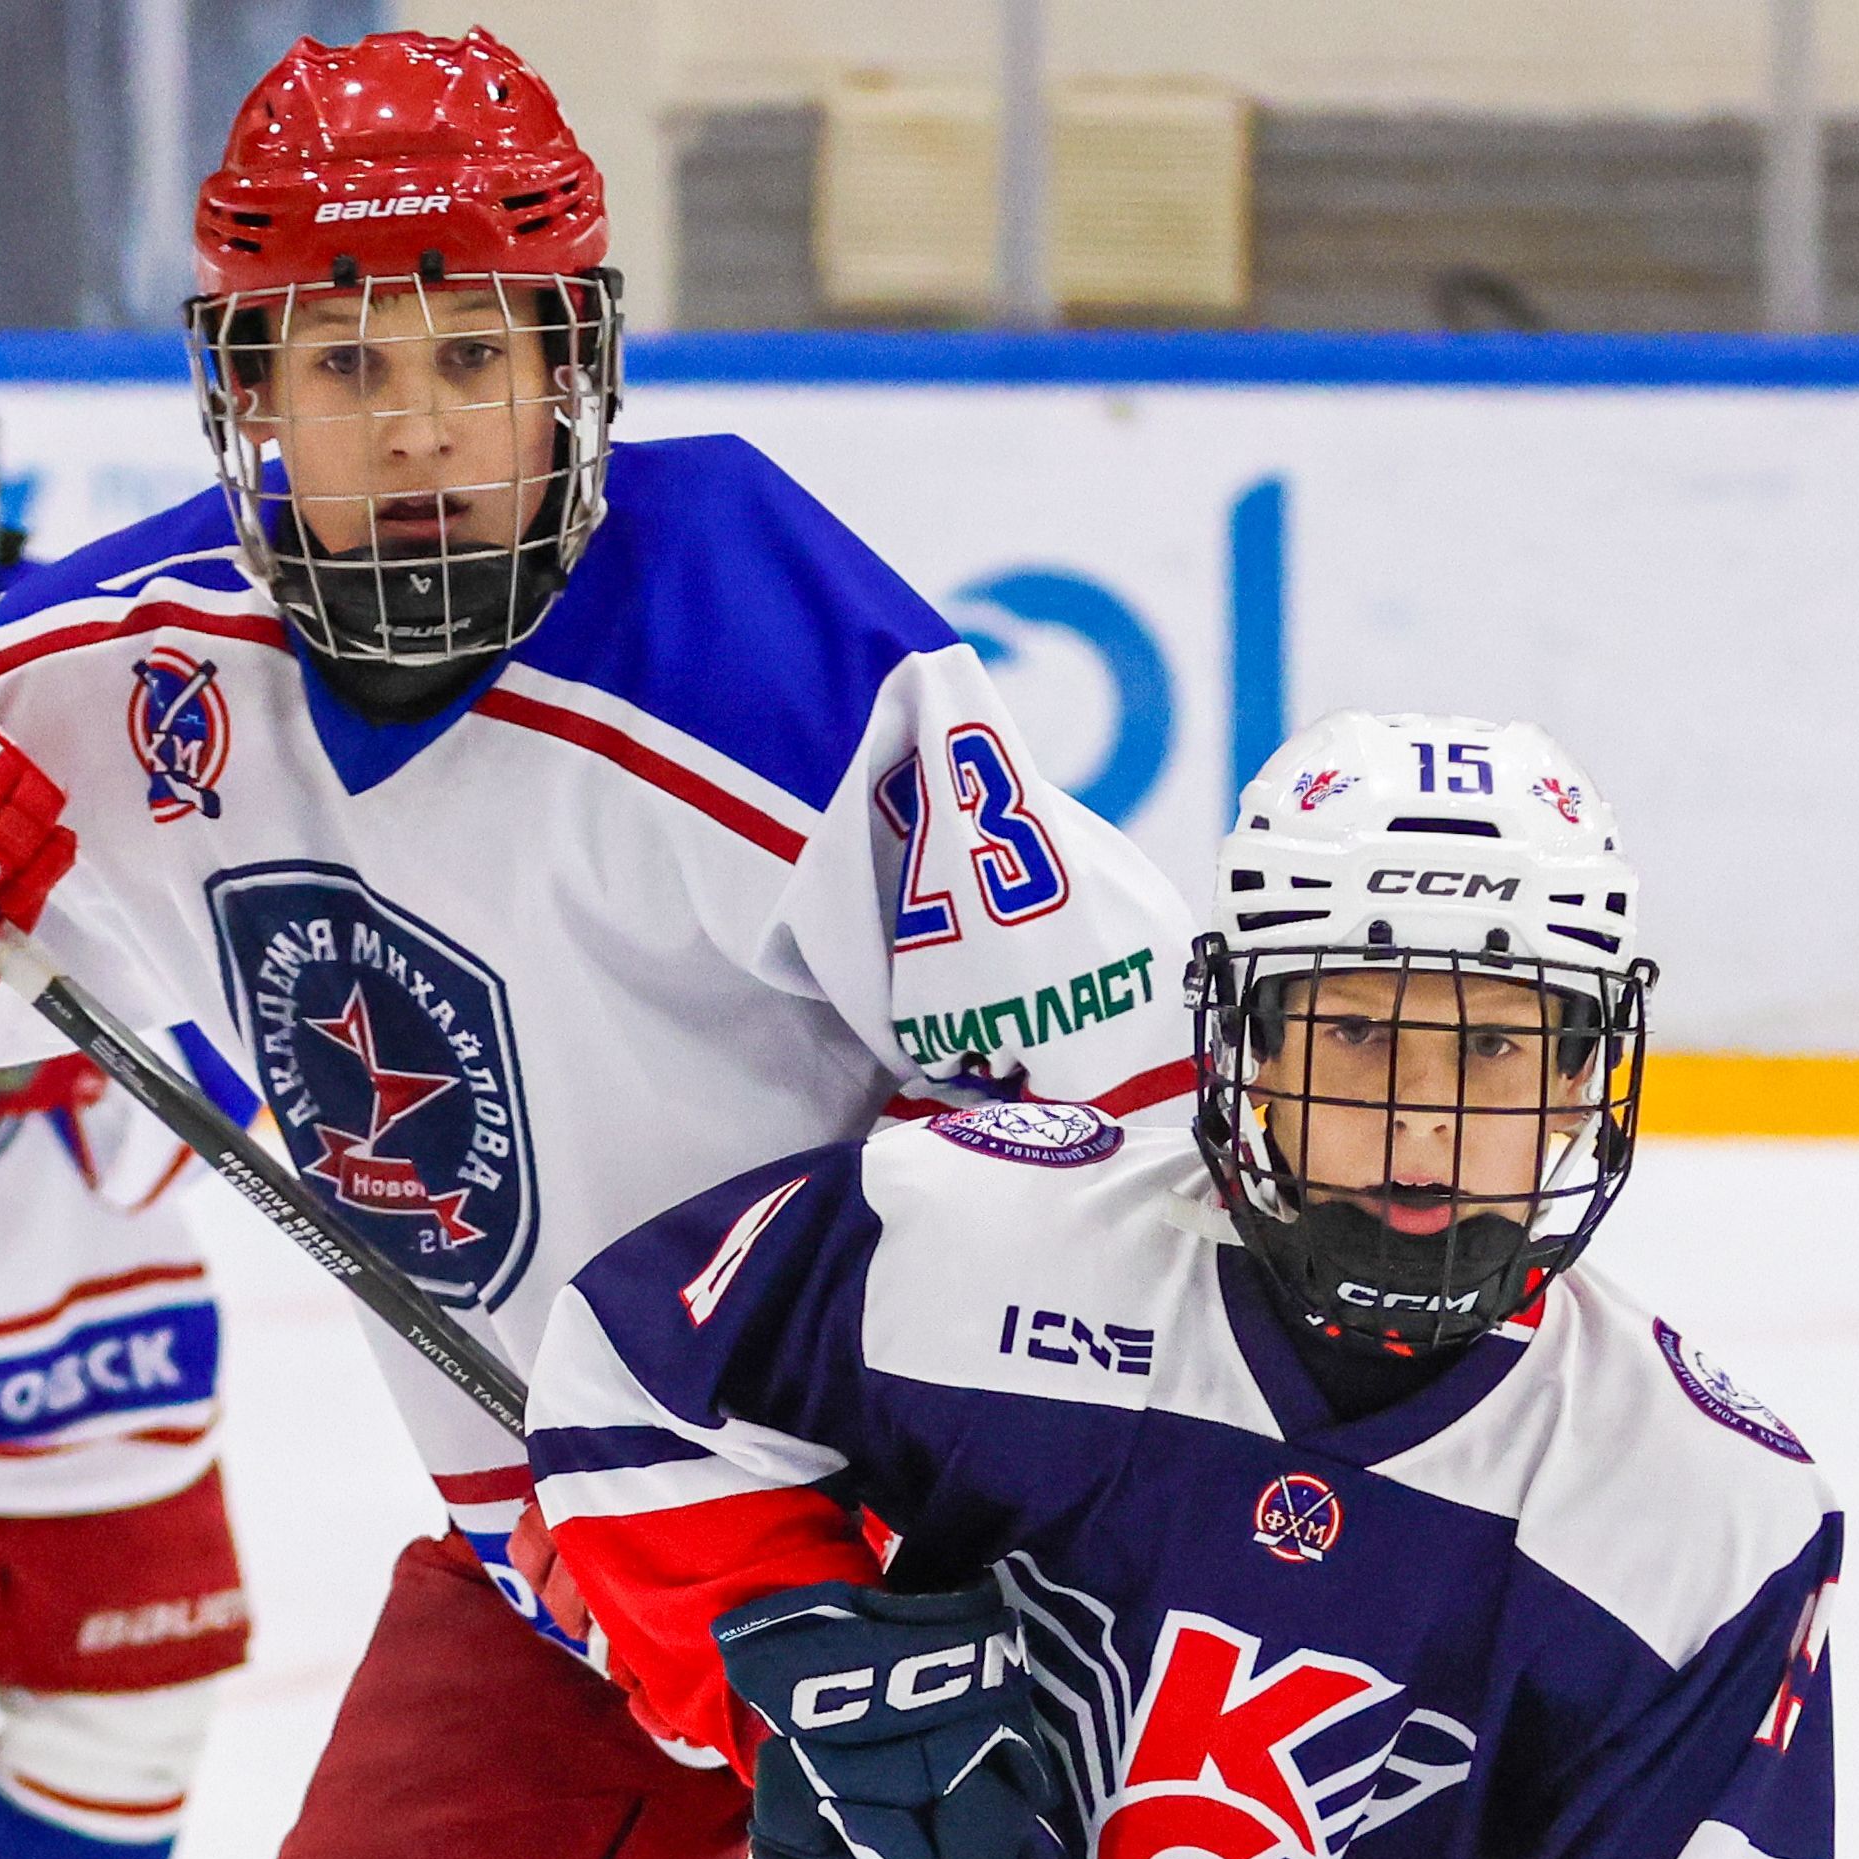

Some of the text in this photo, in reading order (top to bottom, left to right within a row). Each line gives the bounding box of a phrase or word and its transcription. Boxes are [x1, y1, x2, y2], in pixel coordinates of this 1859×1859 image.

[314, 194, 452, 224] BAUER
[1409, 742, 1495, 795] 15
[874, 722, 1070, 955] 23
[1365, 869, 1522, 903] CCM
[219, 1151, 363, 1276] REACTIVE RELEASE
[1336, 1281, 1480, 1314] CCM
[407, 1325, 525, 1432] TWITCH TAPER
[790, 1623, 1032, 1731] CCM
